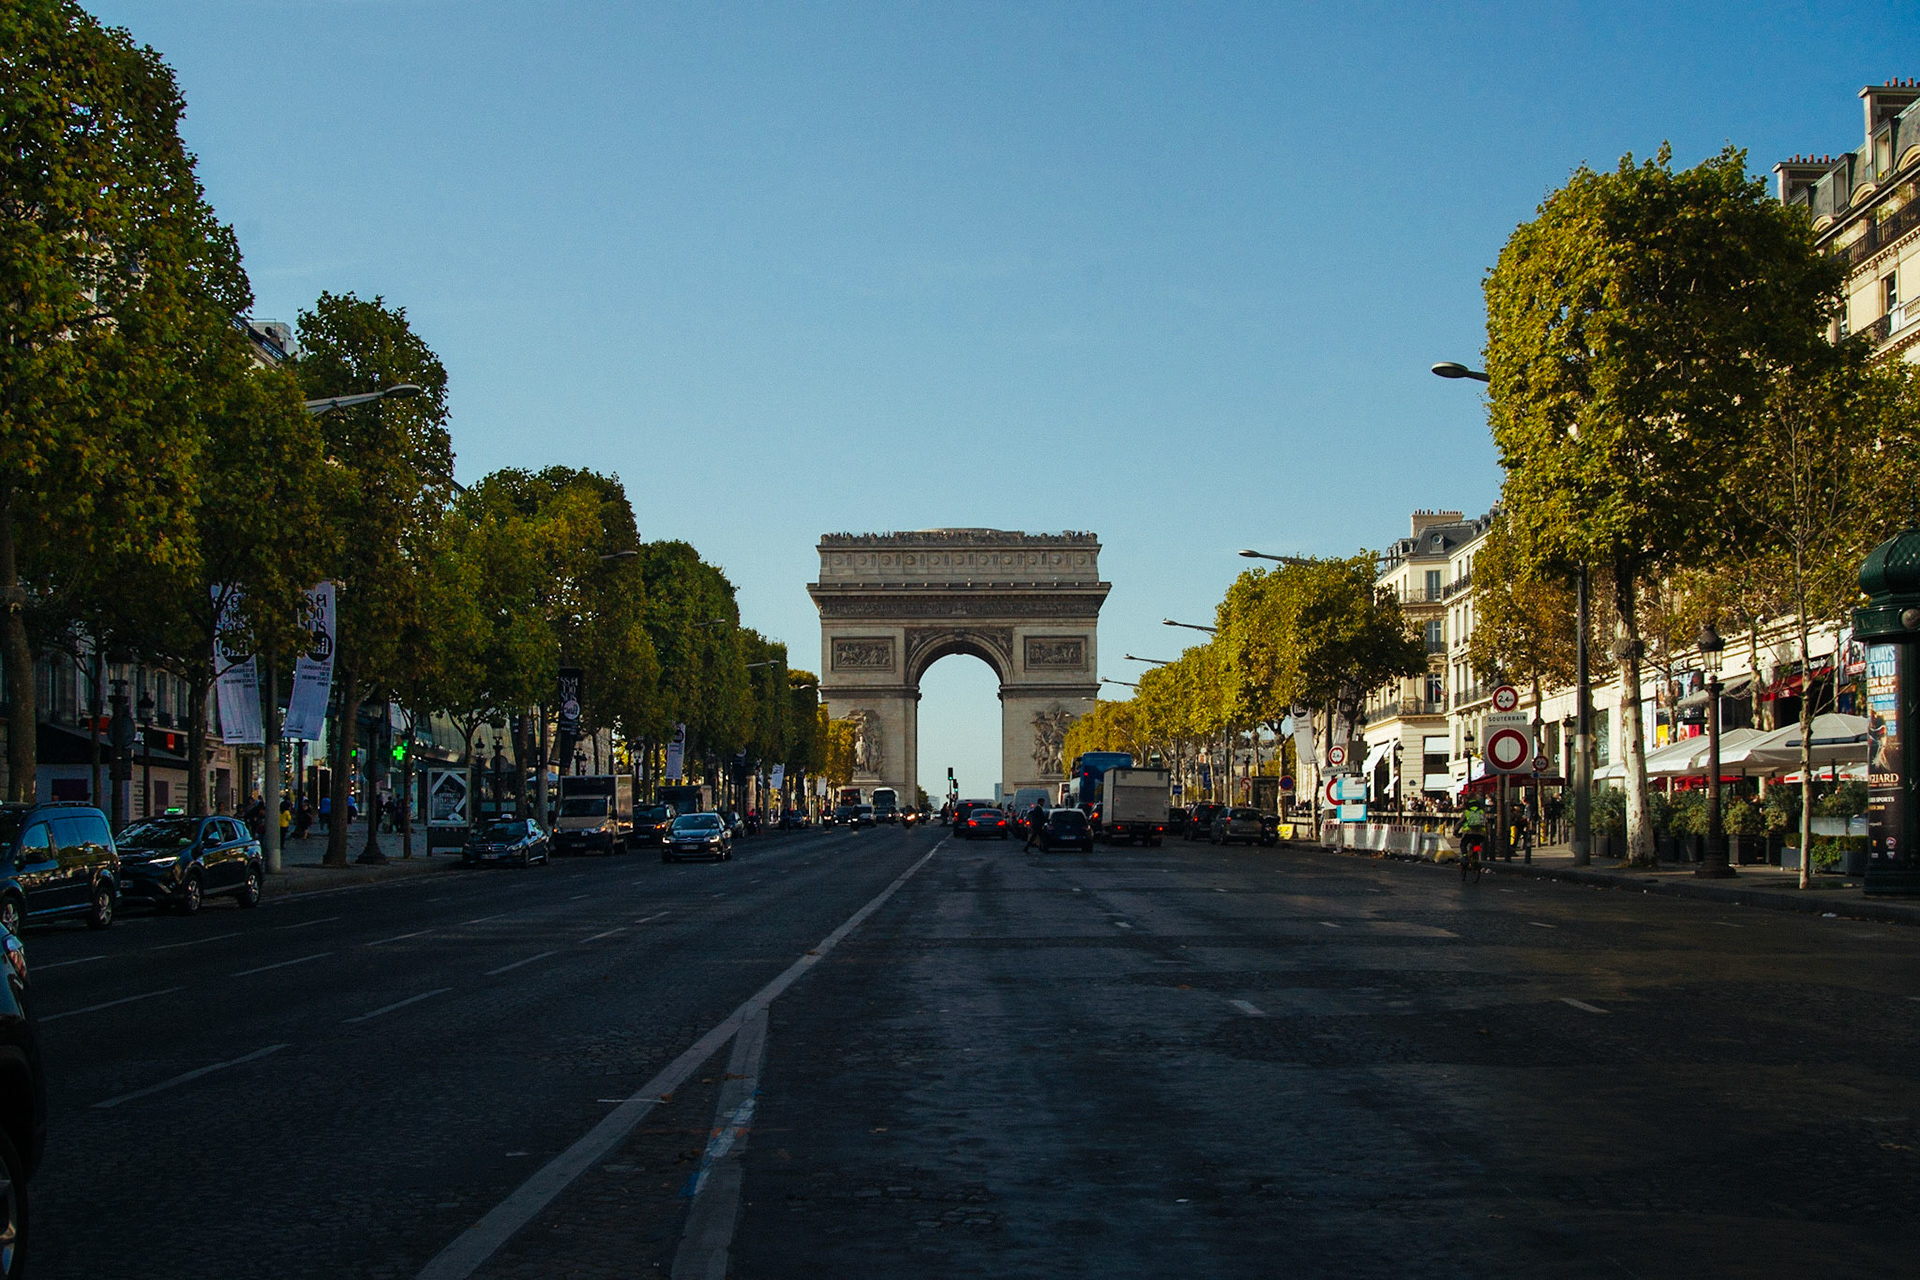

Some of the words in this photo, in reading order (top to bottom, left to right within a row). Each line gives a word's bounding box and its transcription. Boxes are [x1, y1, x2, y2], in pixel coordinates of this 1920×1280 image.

[1874, 660, 1896, 678] YOU
[1880, 677, 1896, 686] OF
[1868, 773, 1900, 784] GUARD
